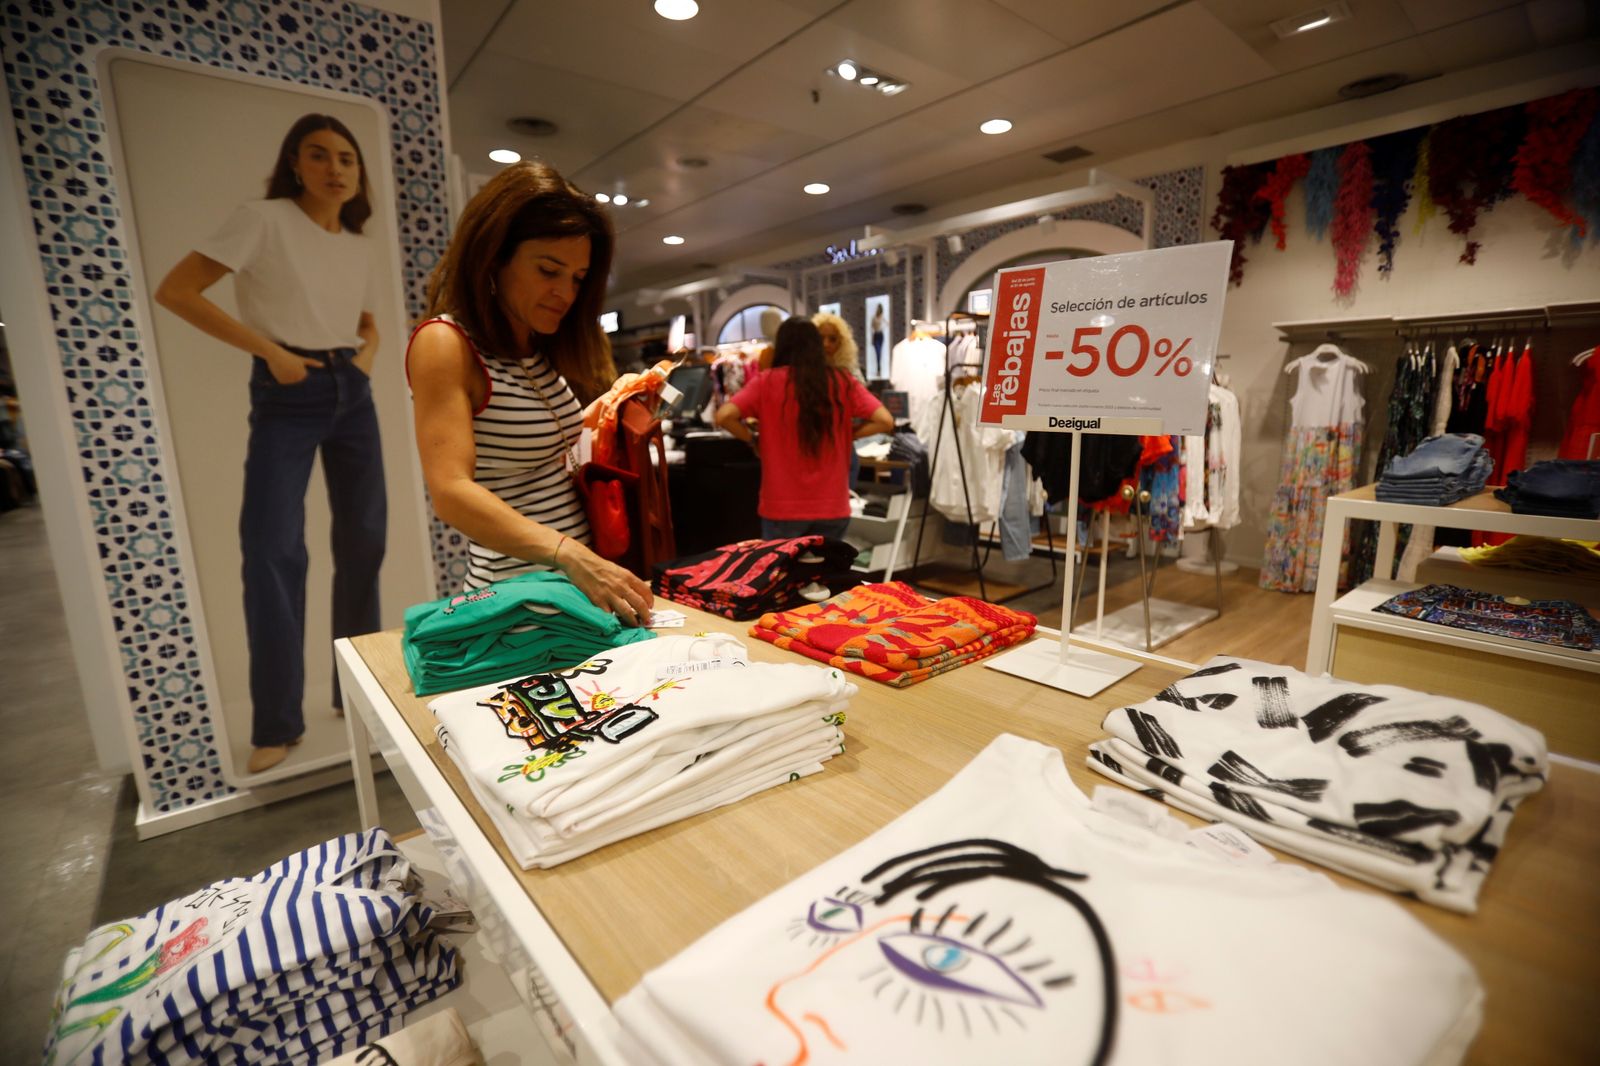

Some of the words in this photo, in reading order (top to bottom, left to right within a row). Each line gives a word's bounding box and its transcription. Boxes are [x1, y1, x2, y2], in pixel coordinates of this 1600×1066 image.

[1050, 298, 1113, 314] Selección
[1117, 296, 1136, 309] de
[1139, 291, 1208, 307] artículos
[998, 292, 1031, 406] rebajas
[1045, 324, 1193, 377] -50%
[989, 383, 1001, 406] Las
[1049, 416, 1101, 431] Desigual
